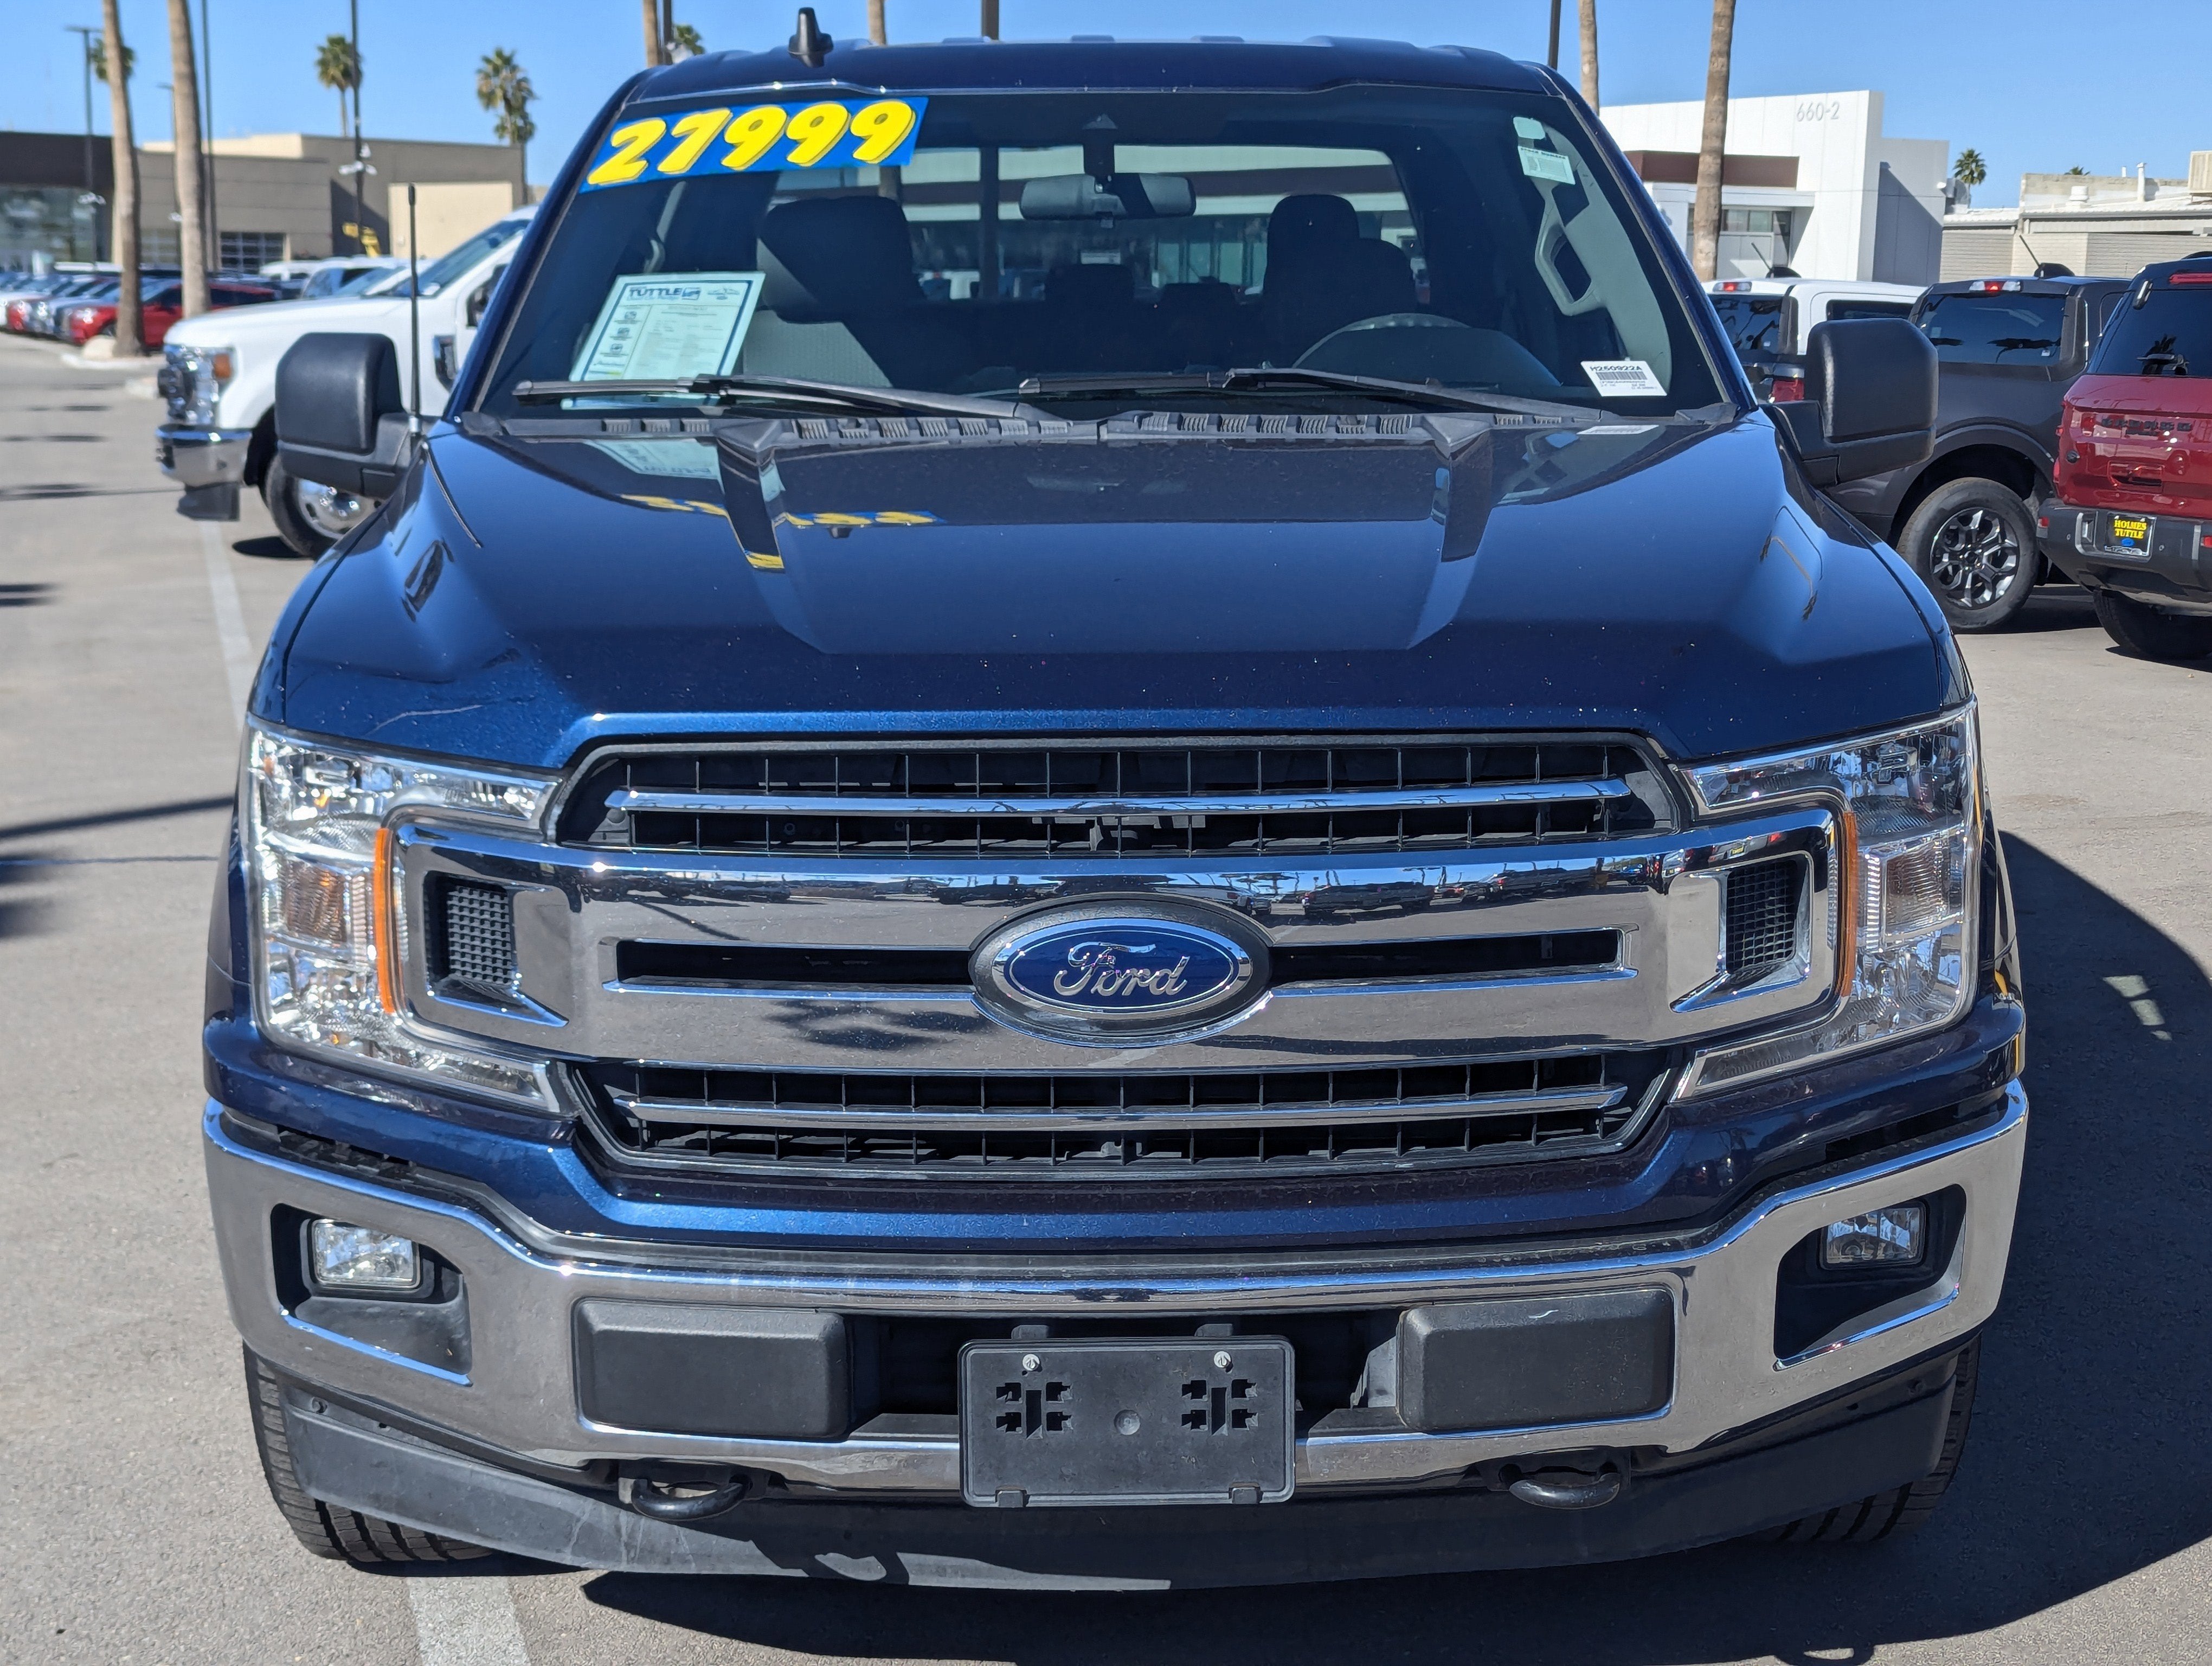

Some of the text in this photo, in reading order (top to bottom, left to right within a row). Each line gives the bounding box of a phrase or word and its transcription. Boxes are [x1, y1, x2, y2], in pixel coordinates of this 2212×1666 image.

[1796, 101, 1840, 121] 660-2
[588, 100, 916, 185] 27999
[629, 287, 682, 297] TUTTLE
[2114, 520, 2147, 530] HOLMES
[2114, 528, 2144, 539] TUTTLE
[1053, 941, 1190, 996] Ford
